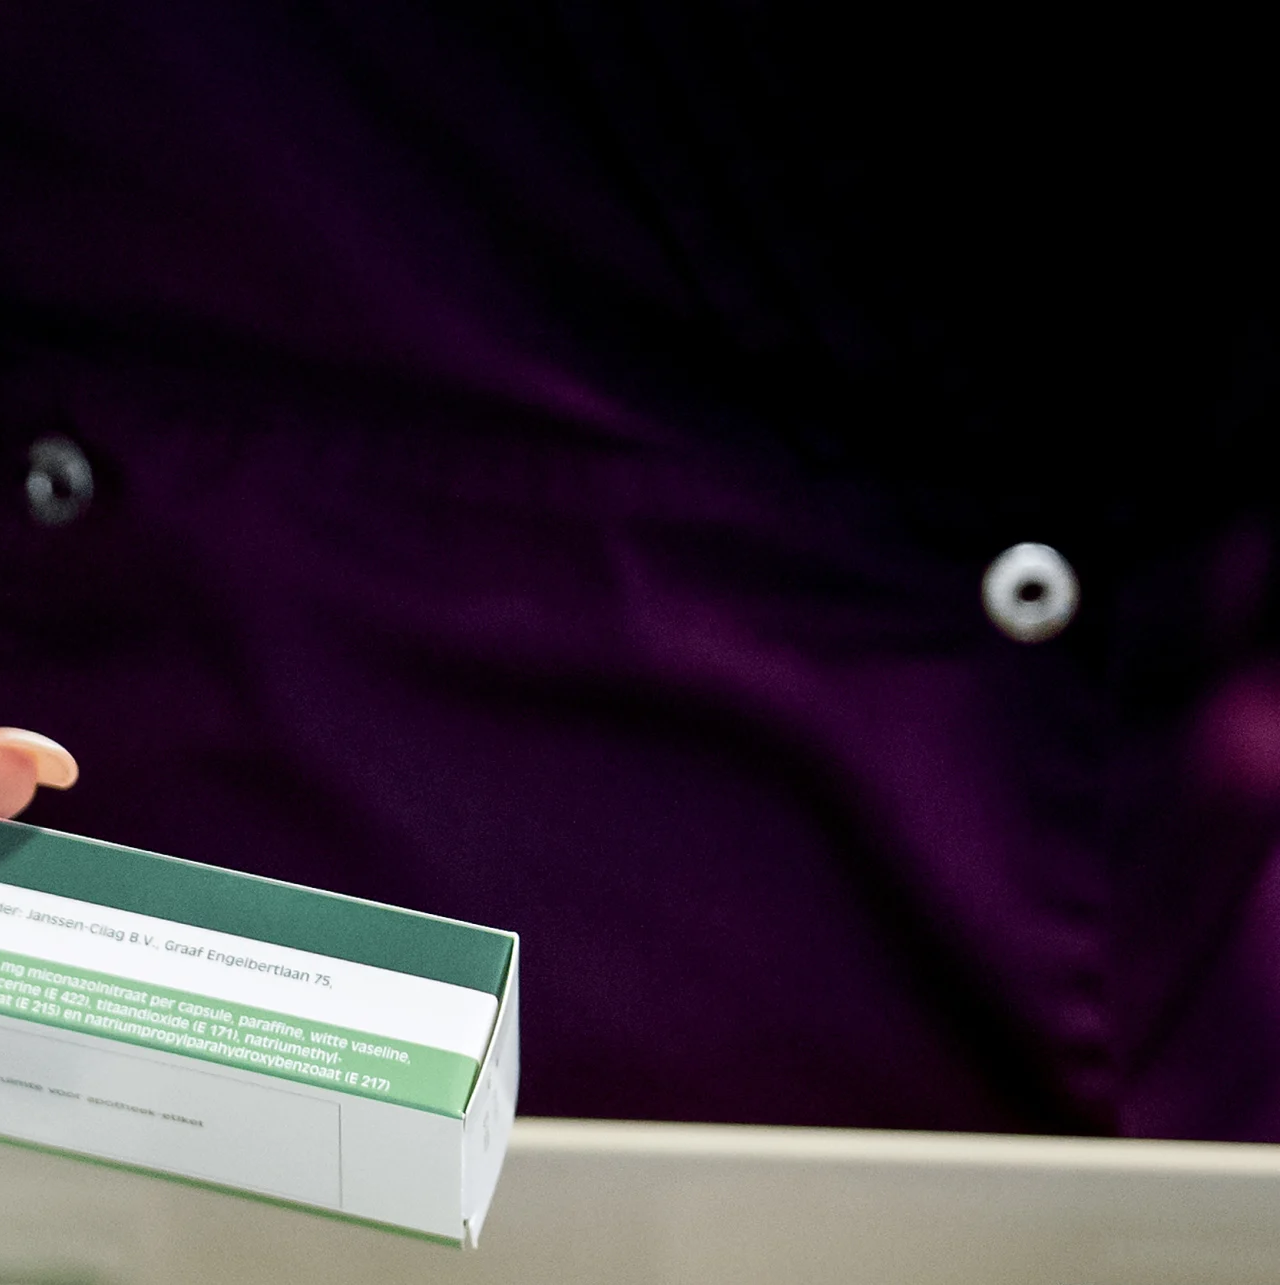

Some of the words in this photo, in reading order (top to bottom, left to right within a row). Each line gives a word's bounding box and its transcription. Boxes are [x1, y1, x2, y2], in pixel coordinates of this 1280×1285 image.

[26, 909, 124, 941] Janssen-Cilag
[164, 940, 204, 958] Graaf
[207, 949, 310, 982] Engelbertlaan
[314, 973, 333, 989] 75,
[0, 961, 24, 977] mg
[28, 966, 147, 1003] miconazolnitraat
[150, 997, 173, 1013] per
[178, 1000, 234, 1025] capsule,
[238, 1014, 305, 1041] paraffine,
[310, 1029, 348, 1049] witte
[351, 1039, 411, 1065] vaseline,
[32, 1000, 60, 1018] 215)
[64, 1008, 82, 1020] en
[344, 1069, 358, 1085] (E
[361, 1075, 391, 1092] 217)
[44, 986, 58, 1000] (E
[96, 997, 189, 1030] titaandioxide
[193, 1019, 206, 1034] (E
[244, 1033, 342, 1065] natriumethyl-
